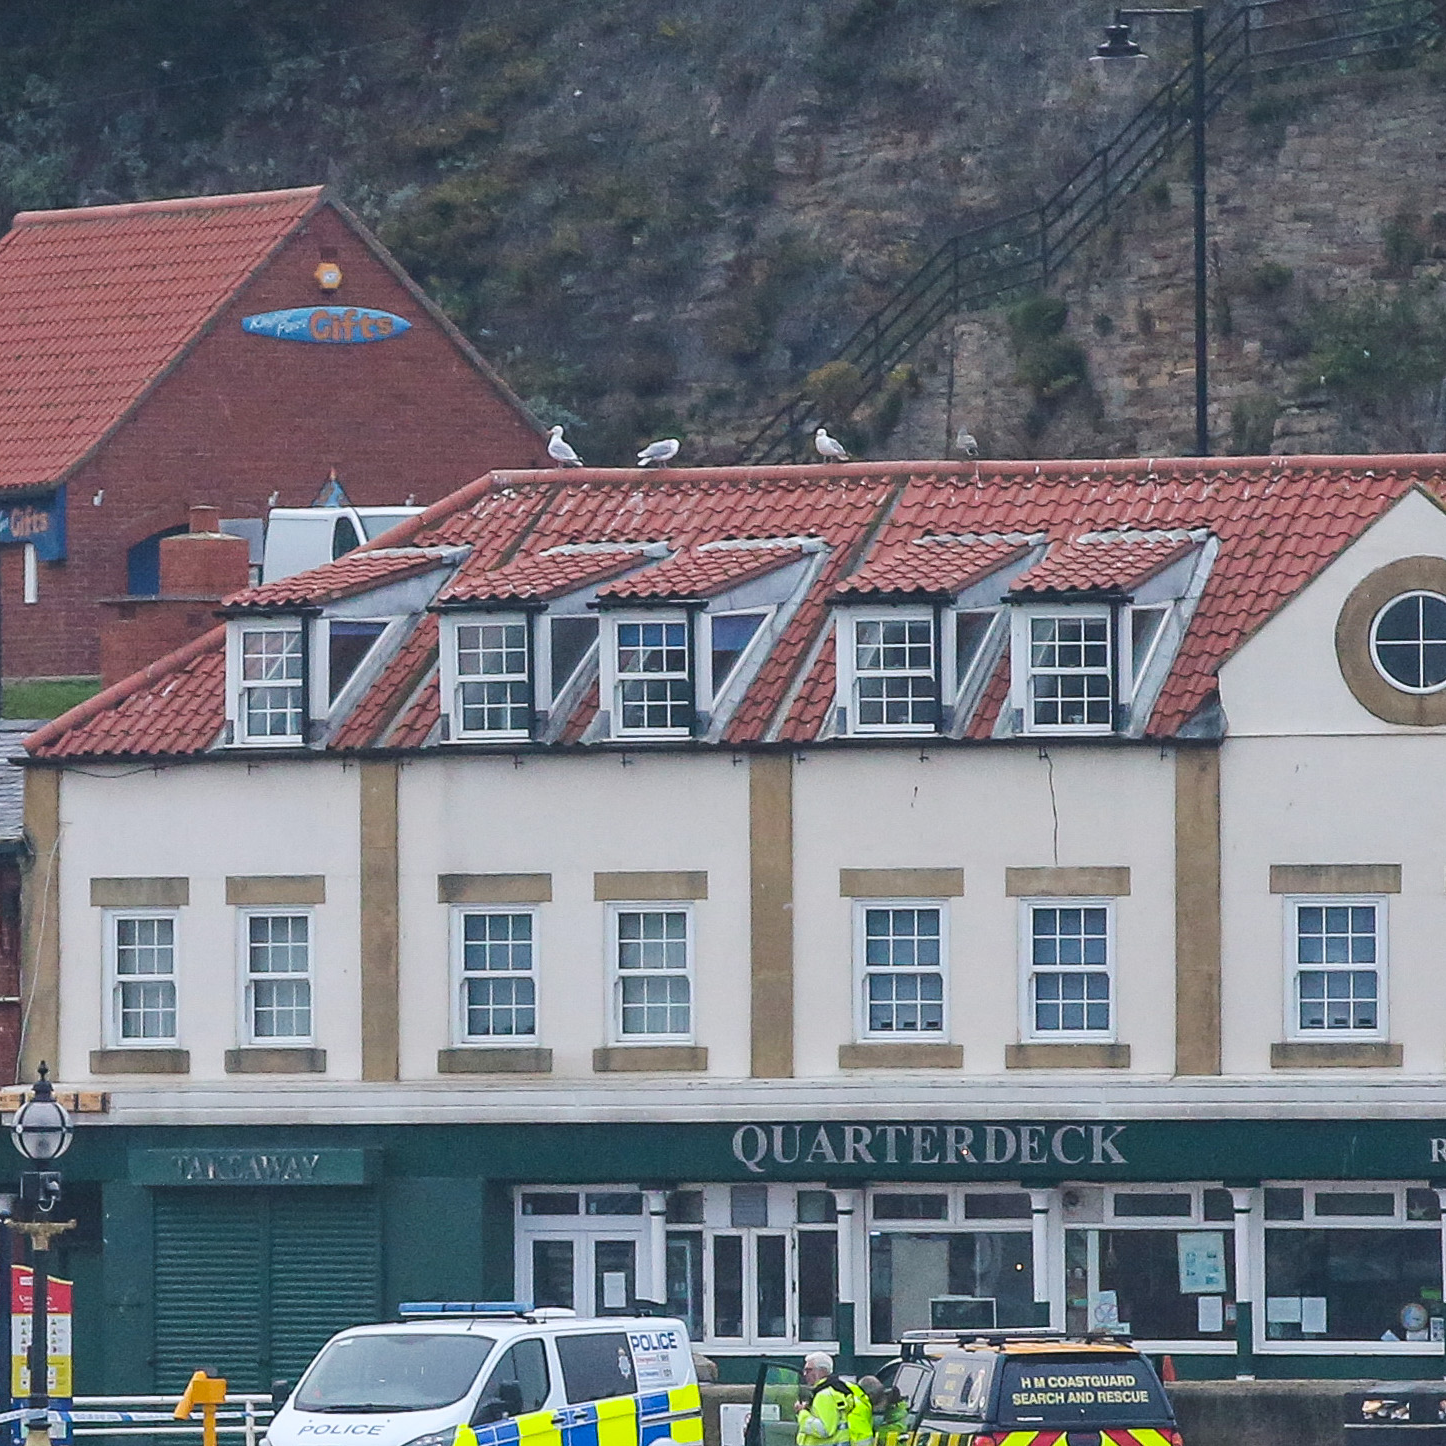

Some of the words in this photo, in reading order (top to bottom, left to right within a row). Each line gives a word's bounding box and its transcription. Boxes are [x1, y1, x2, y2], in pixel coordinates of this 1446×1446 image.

[310, 309, 392, 341] Gifts
[10, 506, 49, 537] Gifts
[731, 1124, 1129, 1173] QUARTERDECK
[171, 1154, 319, 1180] TAKEAWAY
[630, 1332, 677, 1351] POLICE
[1021, 1377, 1031, 1388] H
[1035, 1377, 1046, 1388] M
[1048, 1375, 1136, 1388] COASTGUARD
[1012, 1392, 1065, 1405] SEARCH
[1067, 1391, 1095, 1404] AND
[1097, 1390, 1149, 1403] RESCUE
[298, 1424, 385, 1436] POLICE
